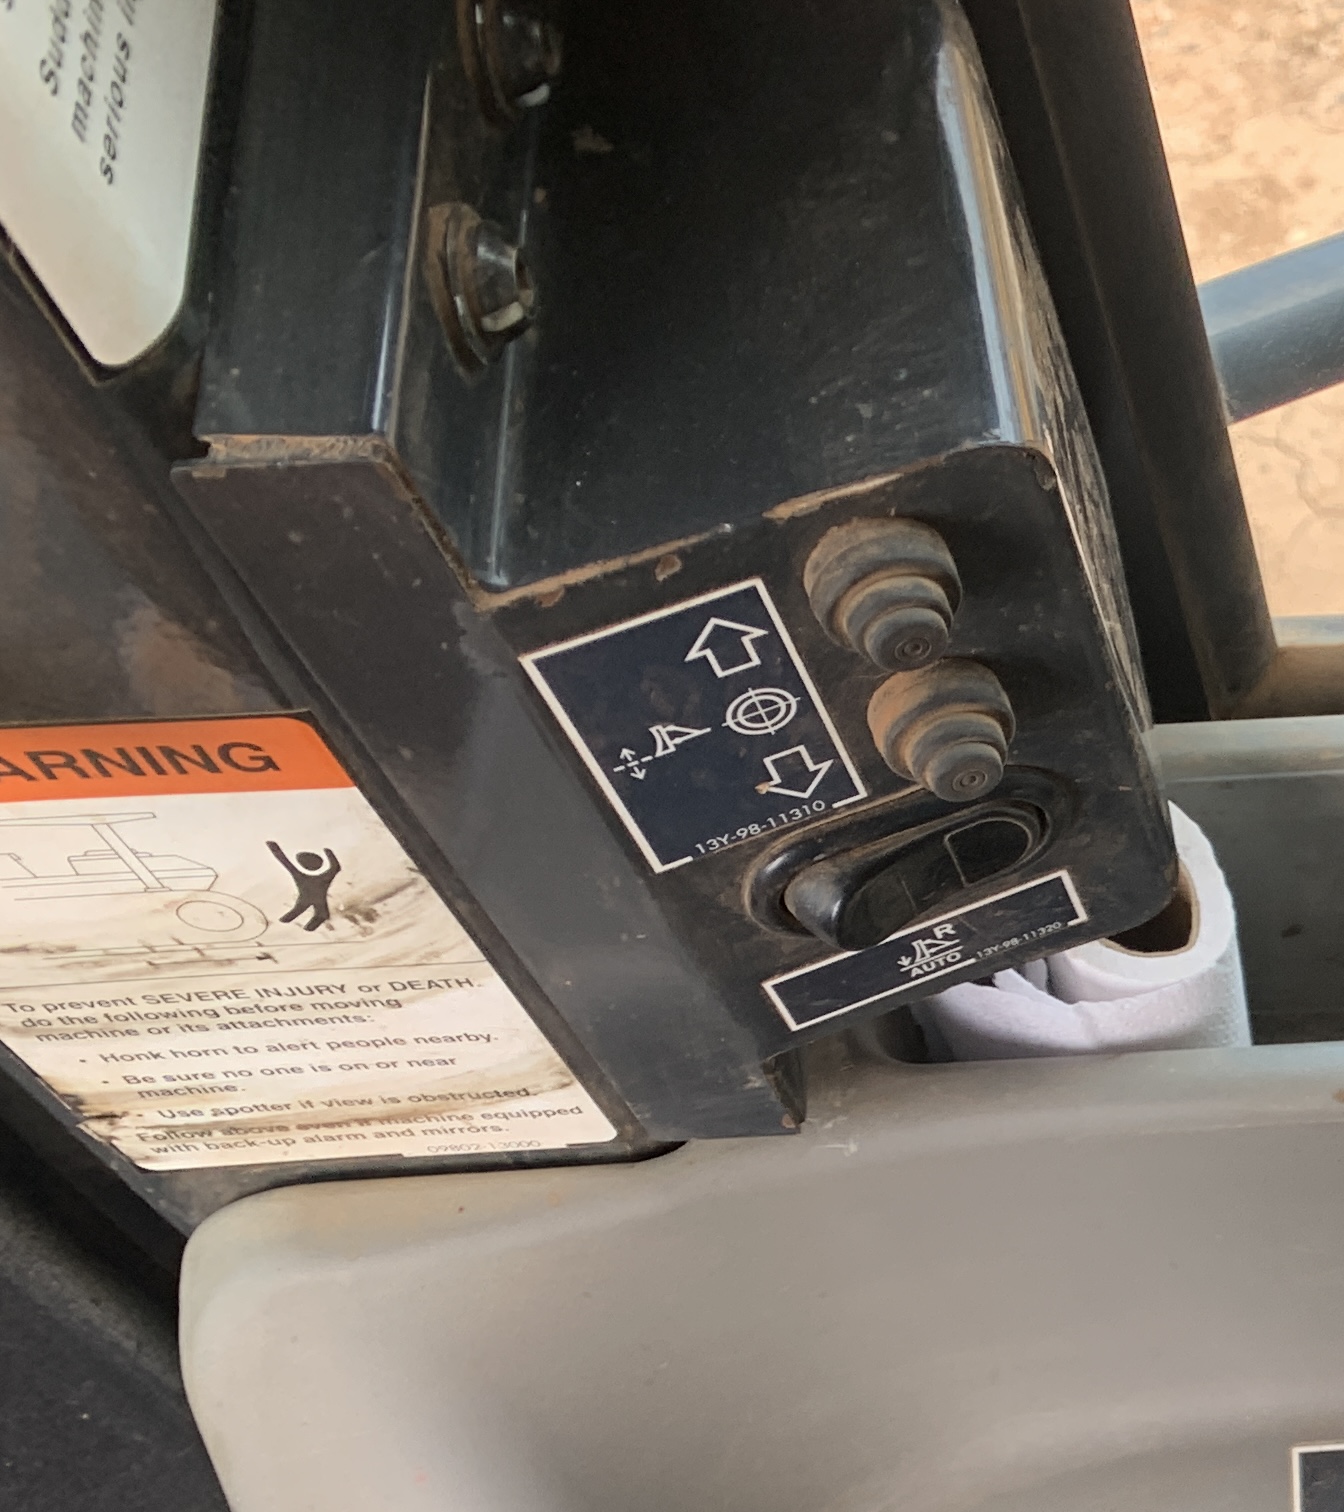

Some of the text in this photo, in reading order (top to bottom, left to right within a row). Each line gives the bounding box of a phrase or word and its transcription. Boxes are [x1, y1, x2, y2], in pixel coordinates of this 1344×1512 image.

[99, 32, 132, 185] serious
[695, 800, 825, 854] 13Y-98-11310
[933, 923, 957, 939] R
[976, 921, 1062, 958] 13Y-98-11320
[910, 952, 962, 978] AUTO
[3, 1002, 36, 1014] To
[42, 996, 137, 1014] prevent
[142, 989, 248, 1005] SEVERE
[255, 984, 347, 998] INJURY
[357, 984, 381, 993] or
[21, 998, 402, 1029] do the following before moving
[36, 1012, 374, 1042] machine or its attachments:
[99, 1031, 499, 1064] Honk horn to alert people nearby.
[122, 1056, 457, 1085] Be sure no one is on or near
[137, 1084, 246, 1099] machine.
[158, 1108, 204, 1119] Use
[211, 1101, 292, 1116] spotter
[299, 1099, 315, 1109] if
[320, 1096, 373, 1107] view
[380, 1096, 401, 1104] is
[136, 1126, 213, 1142] Follow
[220, 1123, 291, 1136] above
[379, 1112, 474, 1126] machine
[481, 1106, 583, 1120] equipped
[150, 1123, 509, 1155] with back-up alarm and mirrors.
[427, 1140, 542, 1153] 09802-13000
